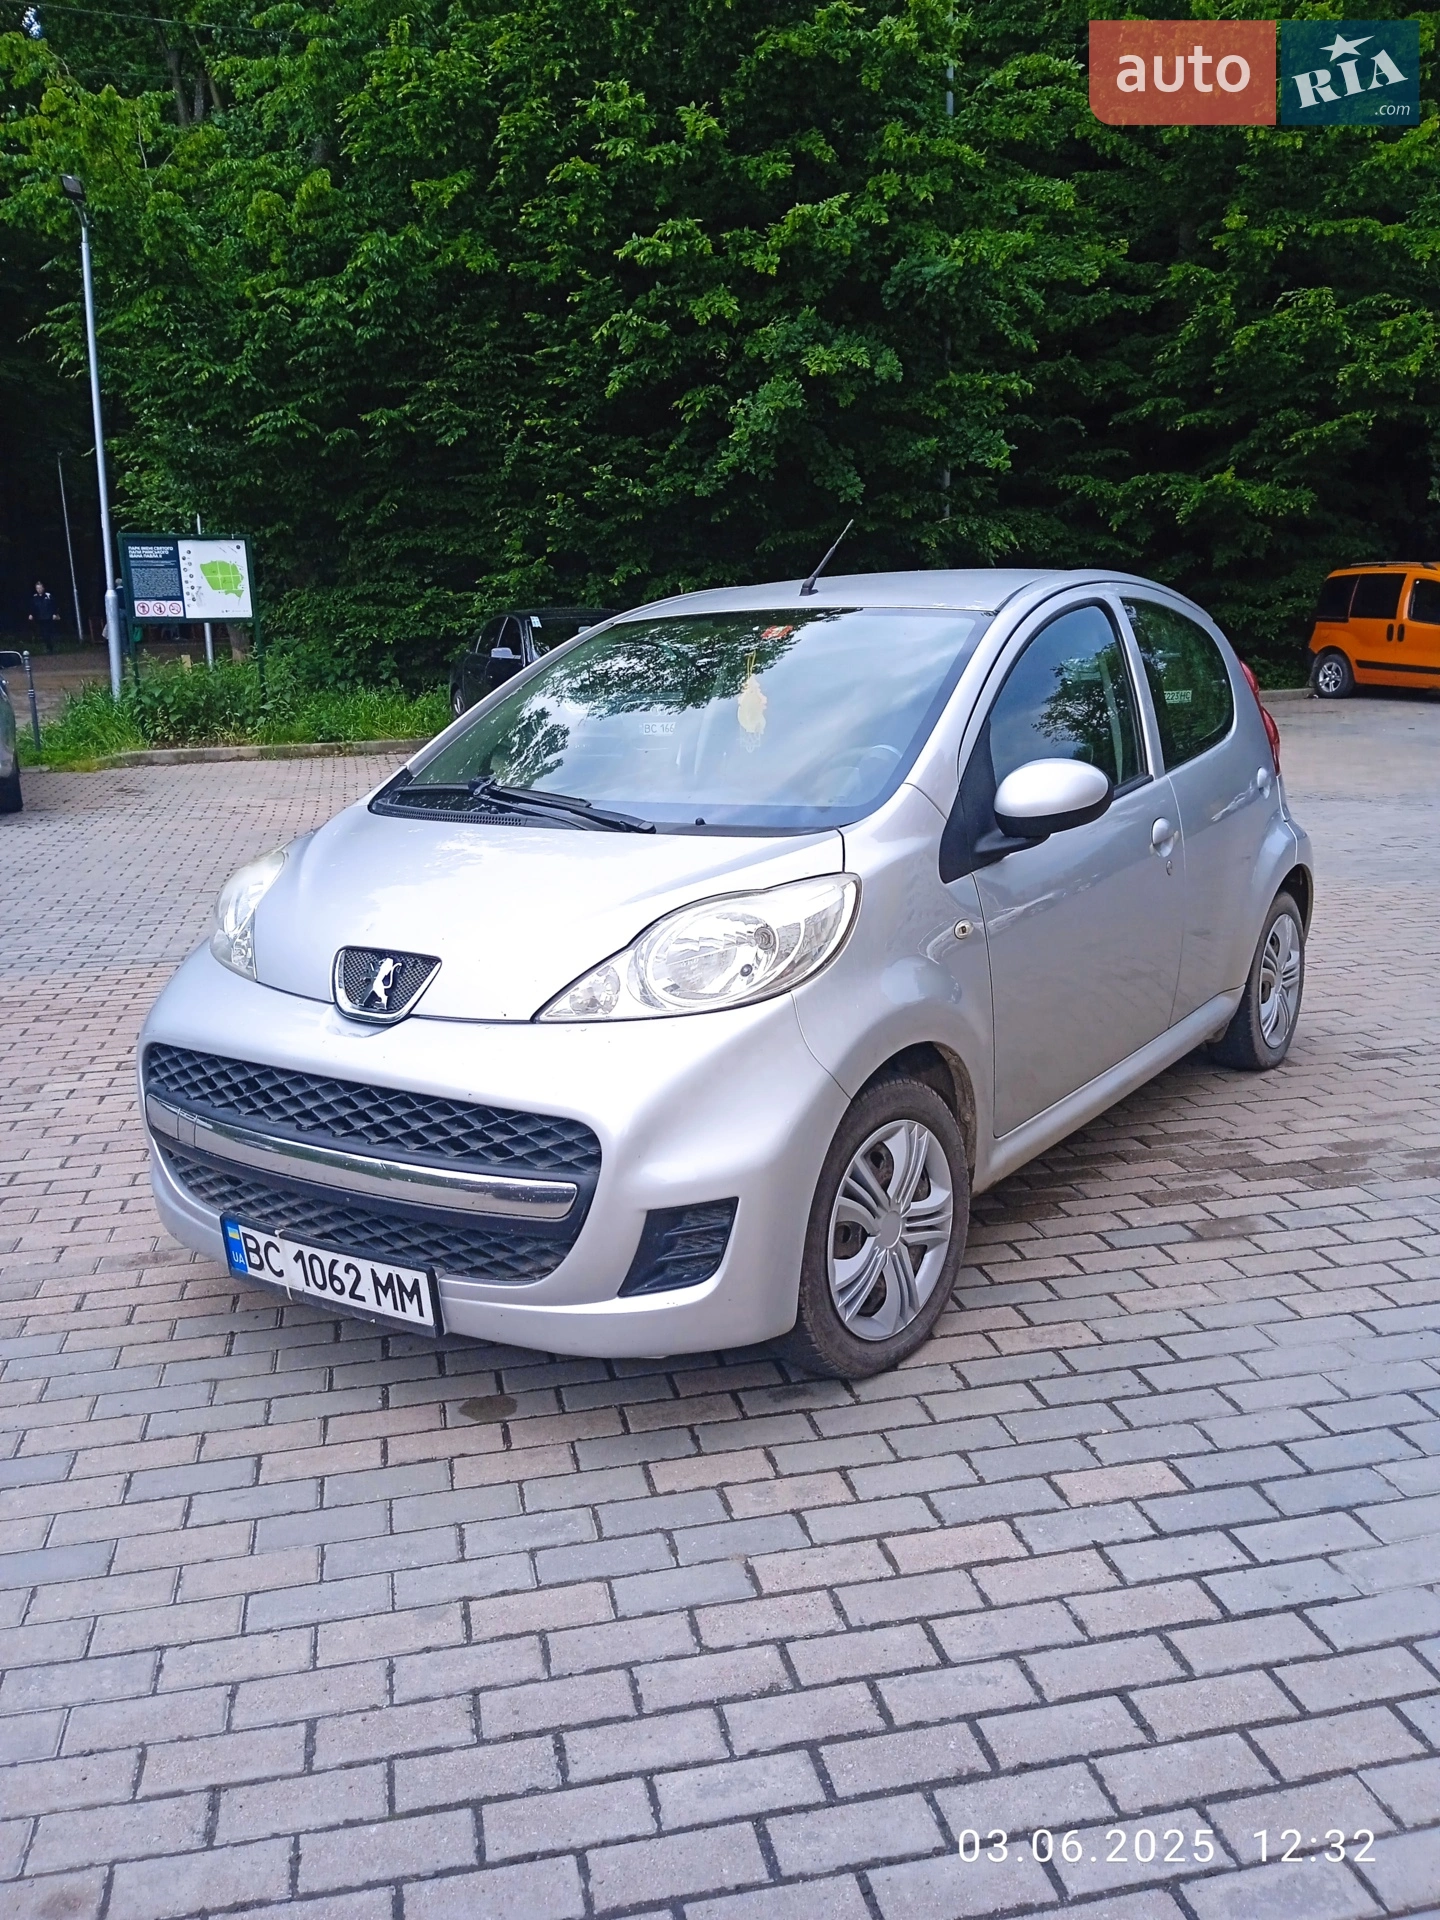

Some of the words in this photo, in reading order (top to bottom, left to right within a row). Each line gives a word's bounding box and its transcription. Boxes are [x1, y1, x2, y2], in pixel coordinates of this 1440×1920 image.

[1164, 692, 1179, 700] 223
[233, 1253, 245, 1264] UA
[242, 1232, 284, 1277] BC
[293, 1250, 367, 1303] 1062
[370, 1268, 425, 1318] MM
